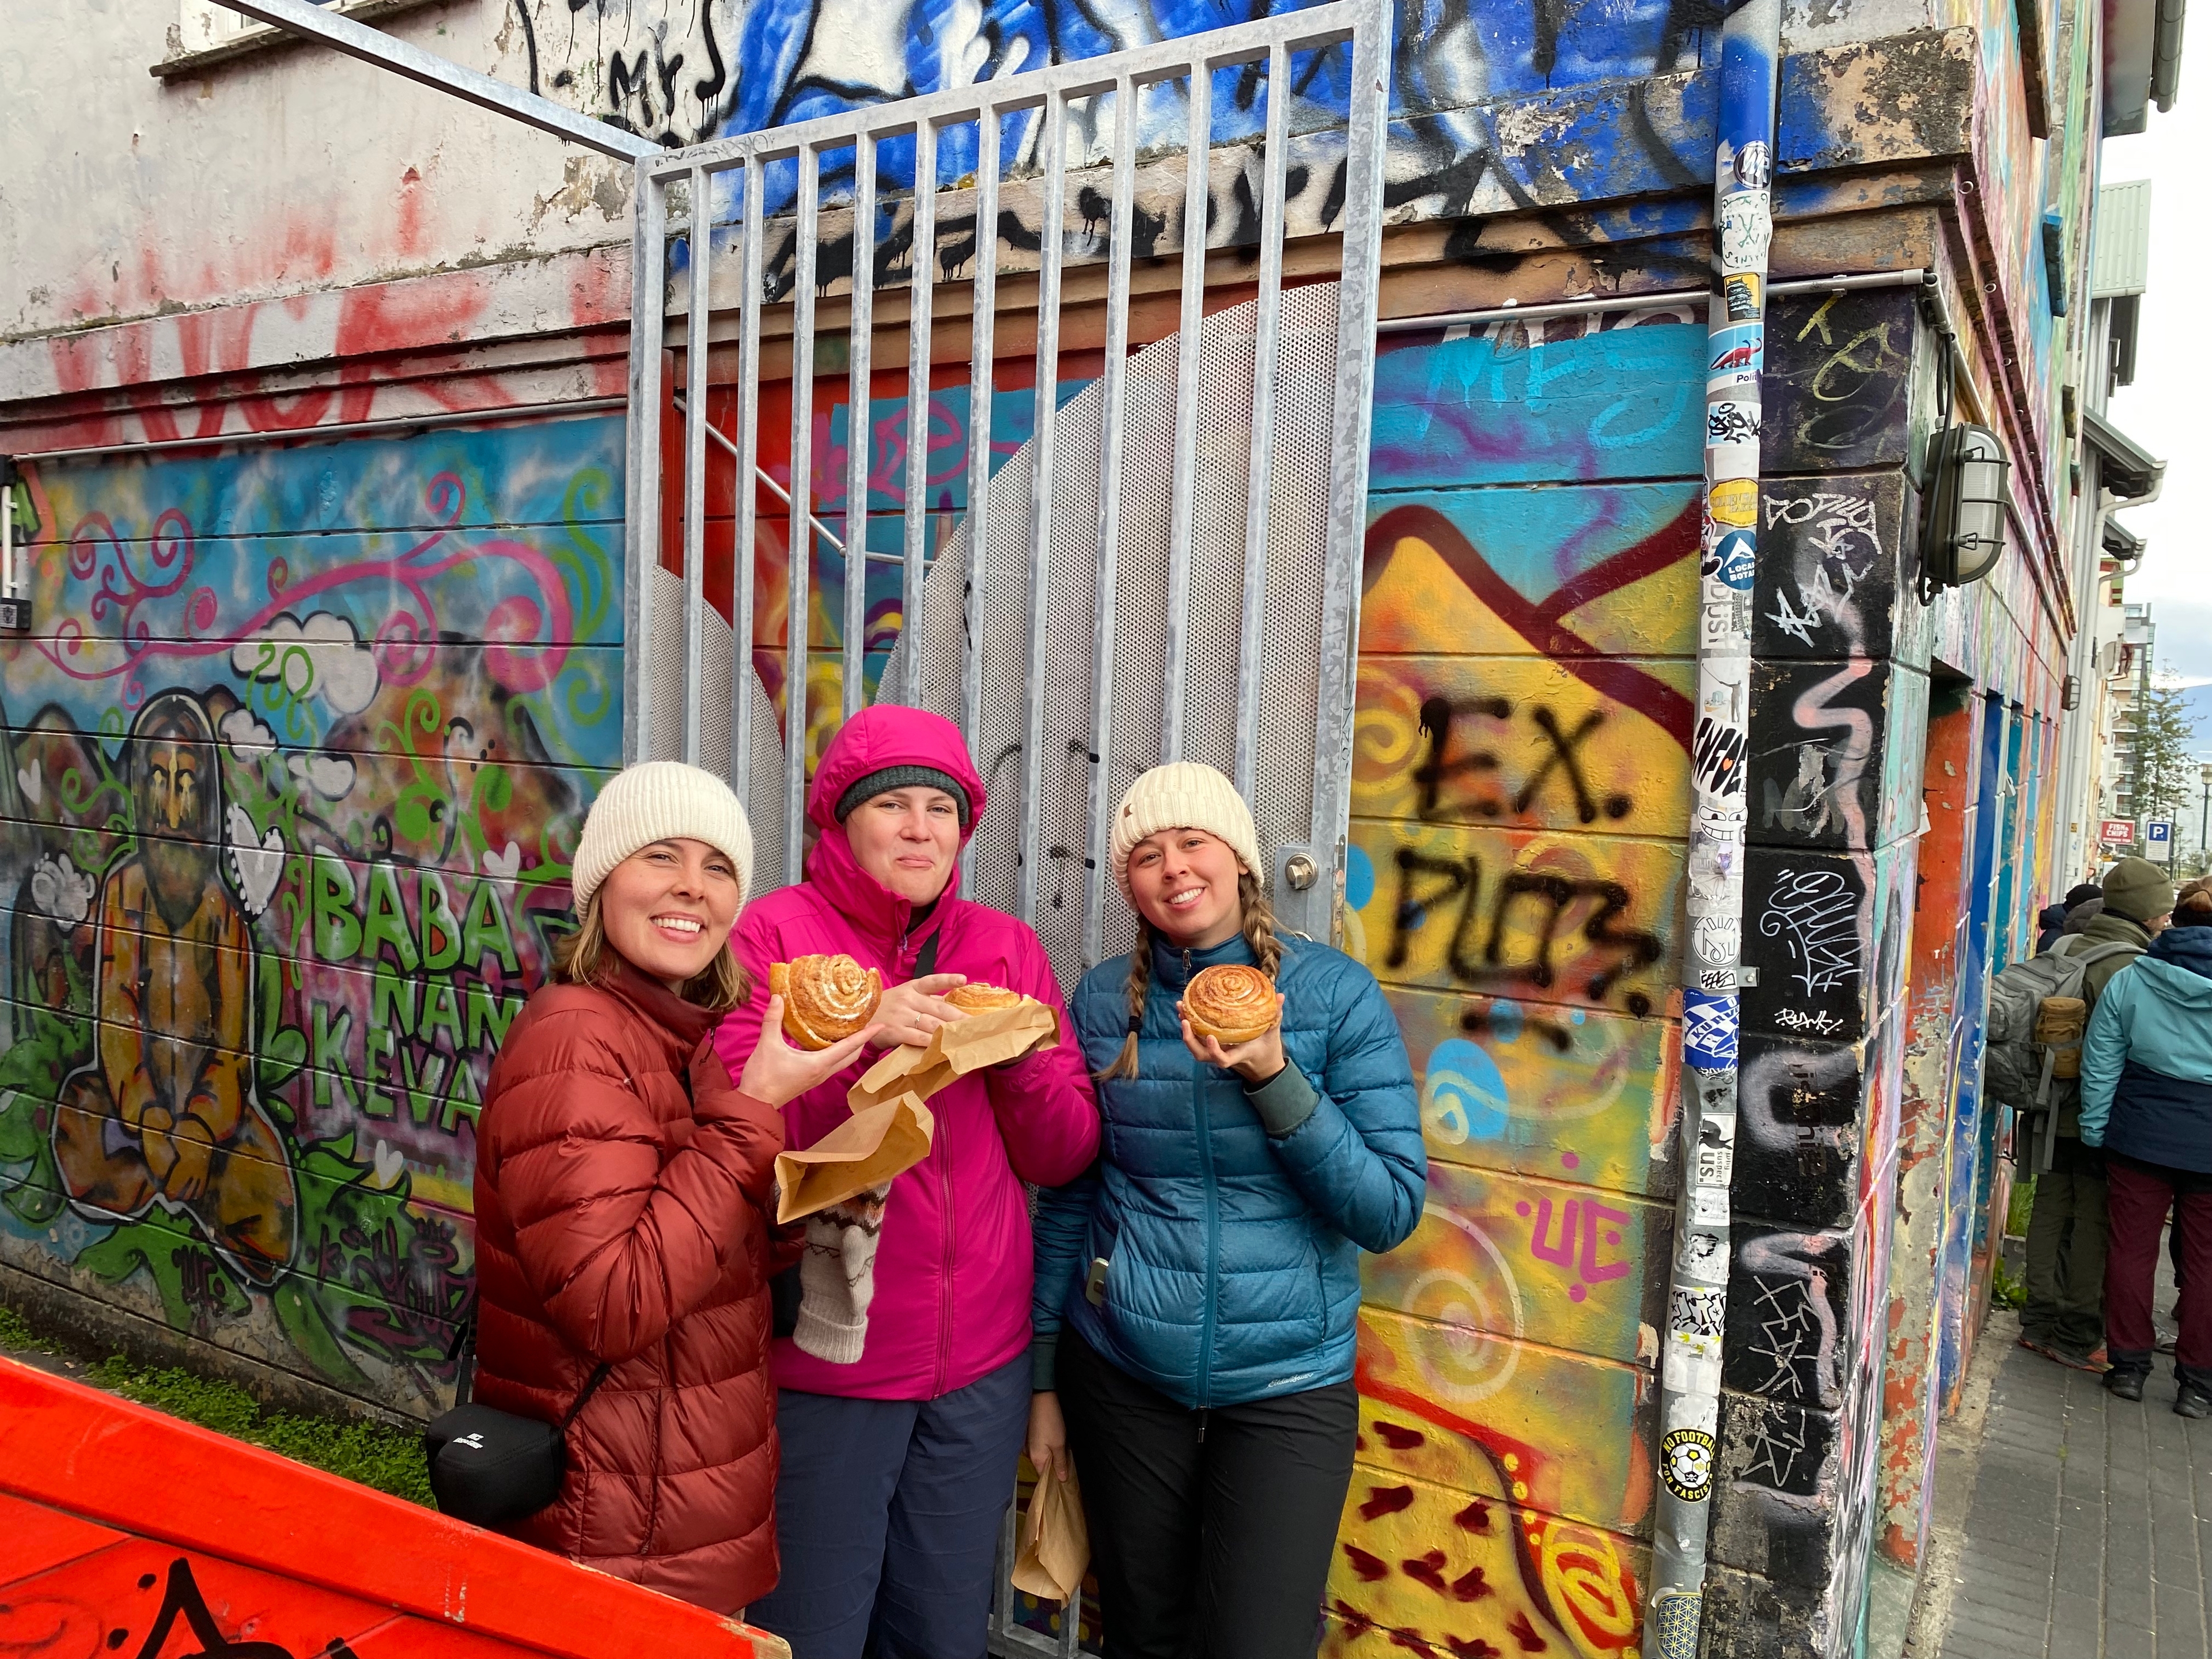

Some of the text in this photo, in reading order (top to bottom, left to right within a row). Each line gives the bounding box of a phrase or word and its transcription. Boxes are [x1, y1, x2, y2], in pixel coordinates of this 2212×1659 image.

[1728, 562, 1755, 574] LOCAS
[1730, 570, 1755, 582] BOTAS
[2106, 830, 2128, 838] CHIPS
[2153, 826, 2164, 839] P
[312, 844, 524, 978] BABA
[1699, 1152, 1715, 1183] us.
[1662, 1431, 1715, 1460] NO FOOTBALL
[1662, 1463, 1713, 1499] FOR FASCISTS
